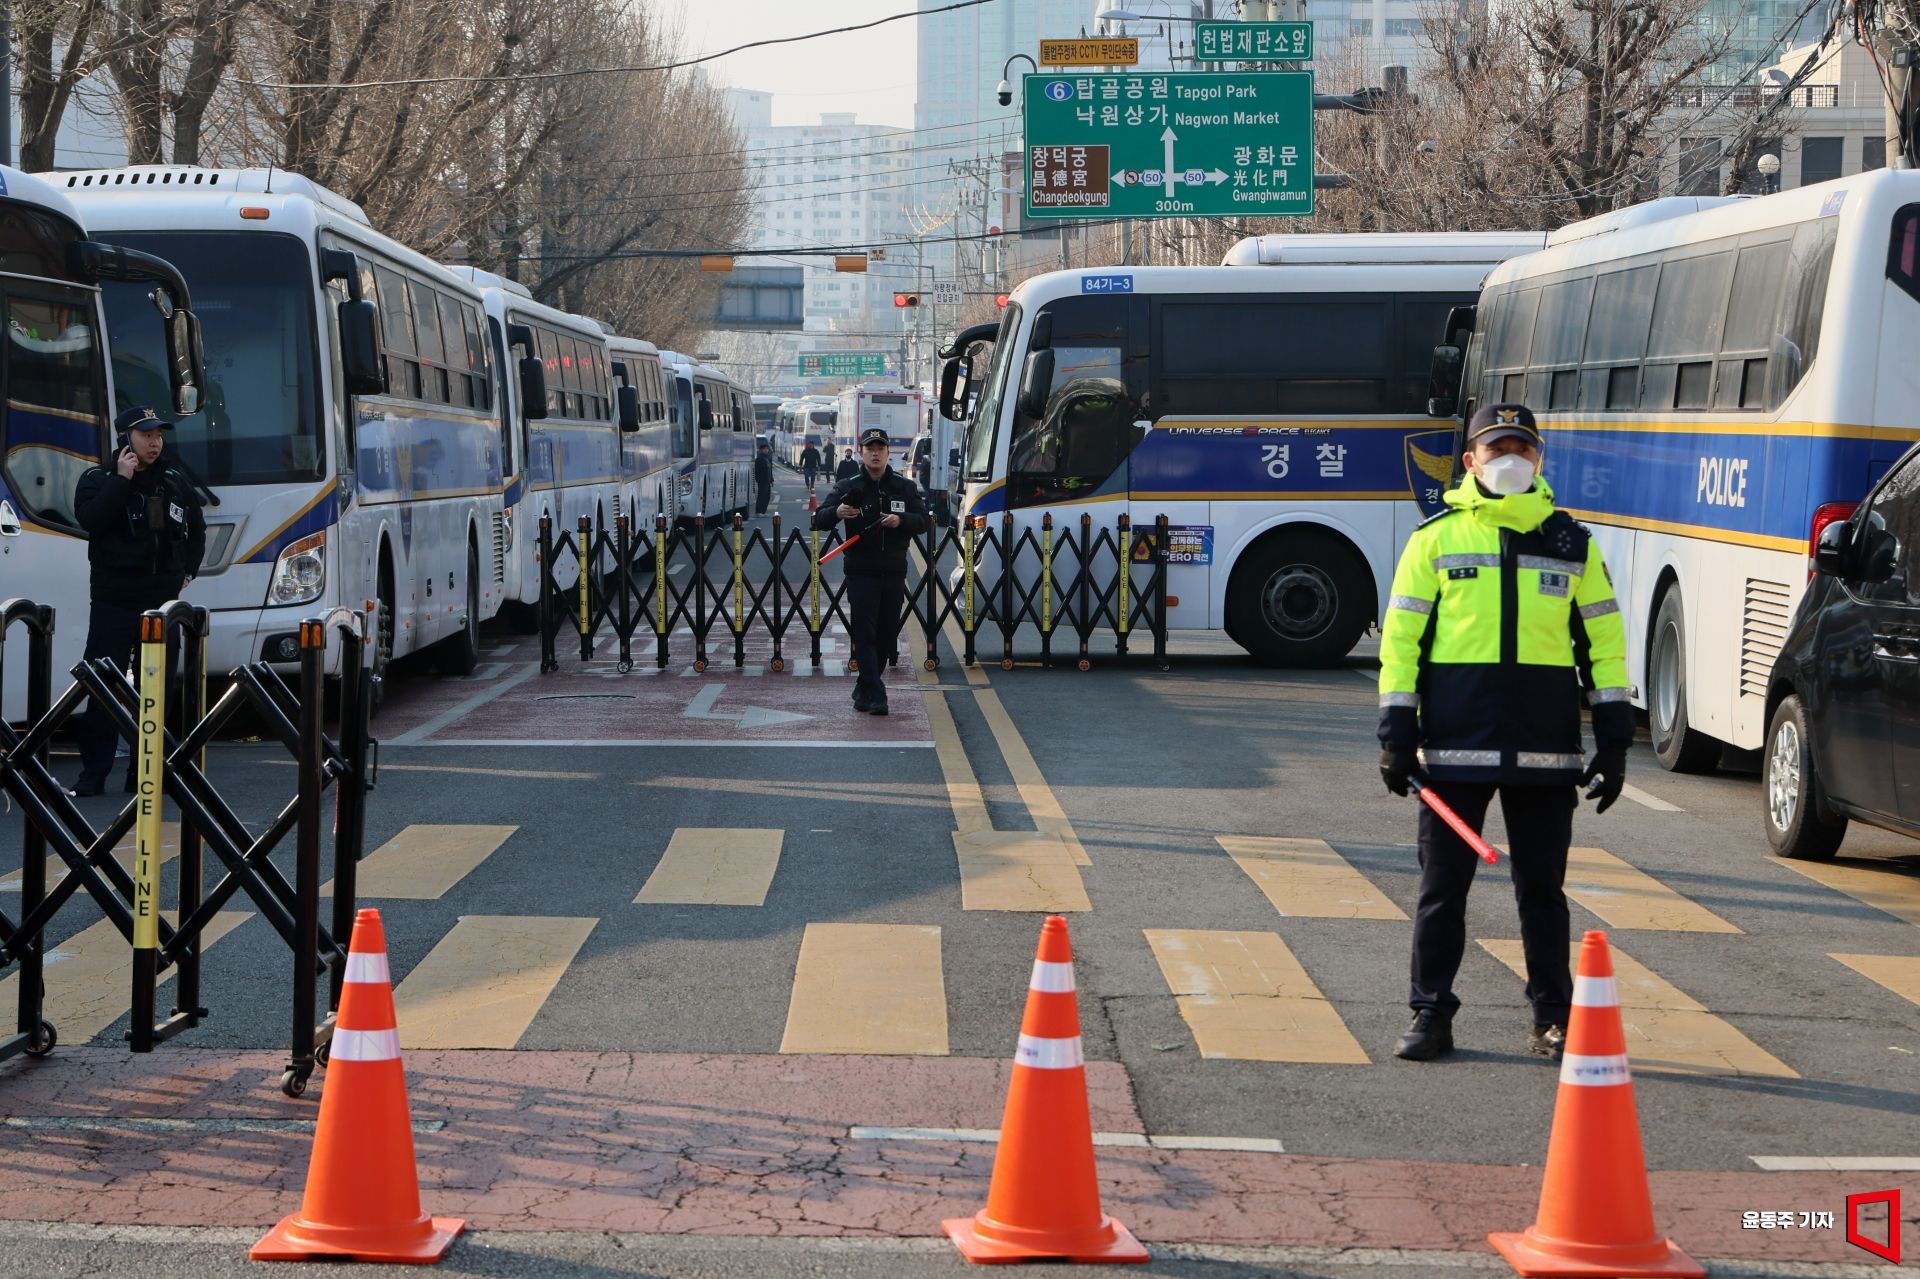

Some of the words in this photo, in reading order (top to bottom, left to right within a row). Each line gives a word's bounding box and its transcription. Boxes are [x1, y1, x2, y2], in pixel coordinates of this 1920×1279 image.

[1202, 29, 1306, 54] 헌법재판소앞
[1043, 44, 1077, 61] 불법주정차
[1079, 44, 1100, 58] CCTV
[1101, 43, 1135, 60] 무인단속중
[1053, 83, 1065, 100] 6
[1076, 77, 1169, 100] 탑골공원
[1175, 85, 1221, 101] Tapgol
[1226, 84, 1257, 98] Park
[1076, 104, 1169, 126] 낙원상가
[1175, 112, 1229, 128] Nagwon
[1233, 111, 1279, 125] Market
[1033, 147, 1087, 168] 창덕궁
[1233, 146, 1298, 166] 광화문
[1033, 170, 1087, 187] 昌德宮
[1145, 173, 1159, 182] 50
[1188, 173, 1202, 182] 50
[1233, 169, 1288, 186] 光化門
[1033, 190, 1107, 205] Changdeokgung
[1233, 189, 1307, 203] Gwanghwamun
[1155, 200, 1193, 211] 300m
[1085, 278, 1130, 290] 84기-3
[1169, 427, 1244, 436] UNIVERSE
[1261, 443, 1347, 479] 경찰
[1697, 456, 1749, 508] POLICE
[140, 697, 156, 816] POLICE
[138, 839, 151, 917] LINE
